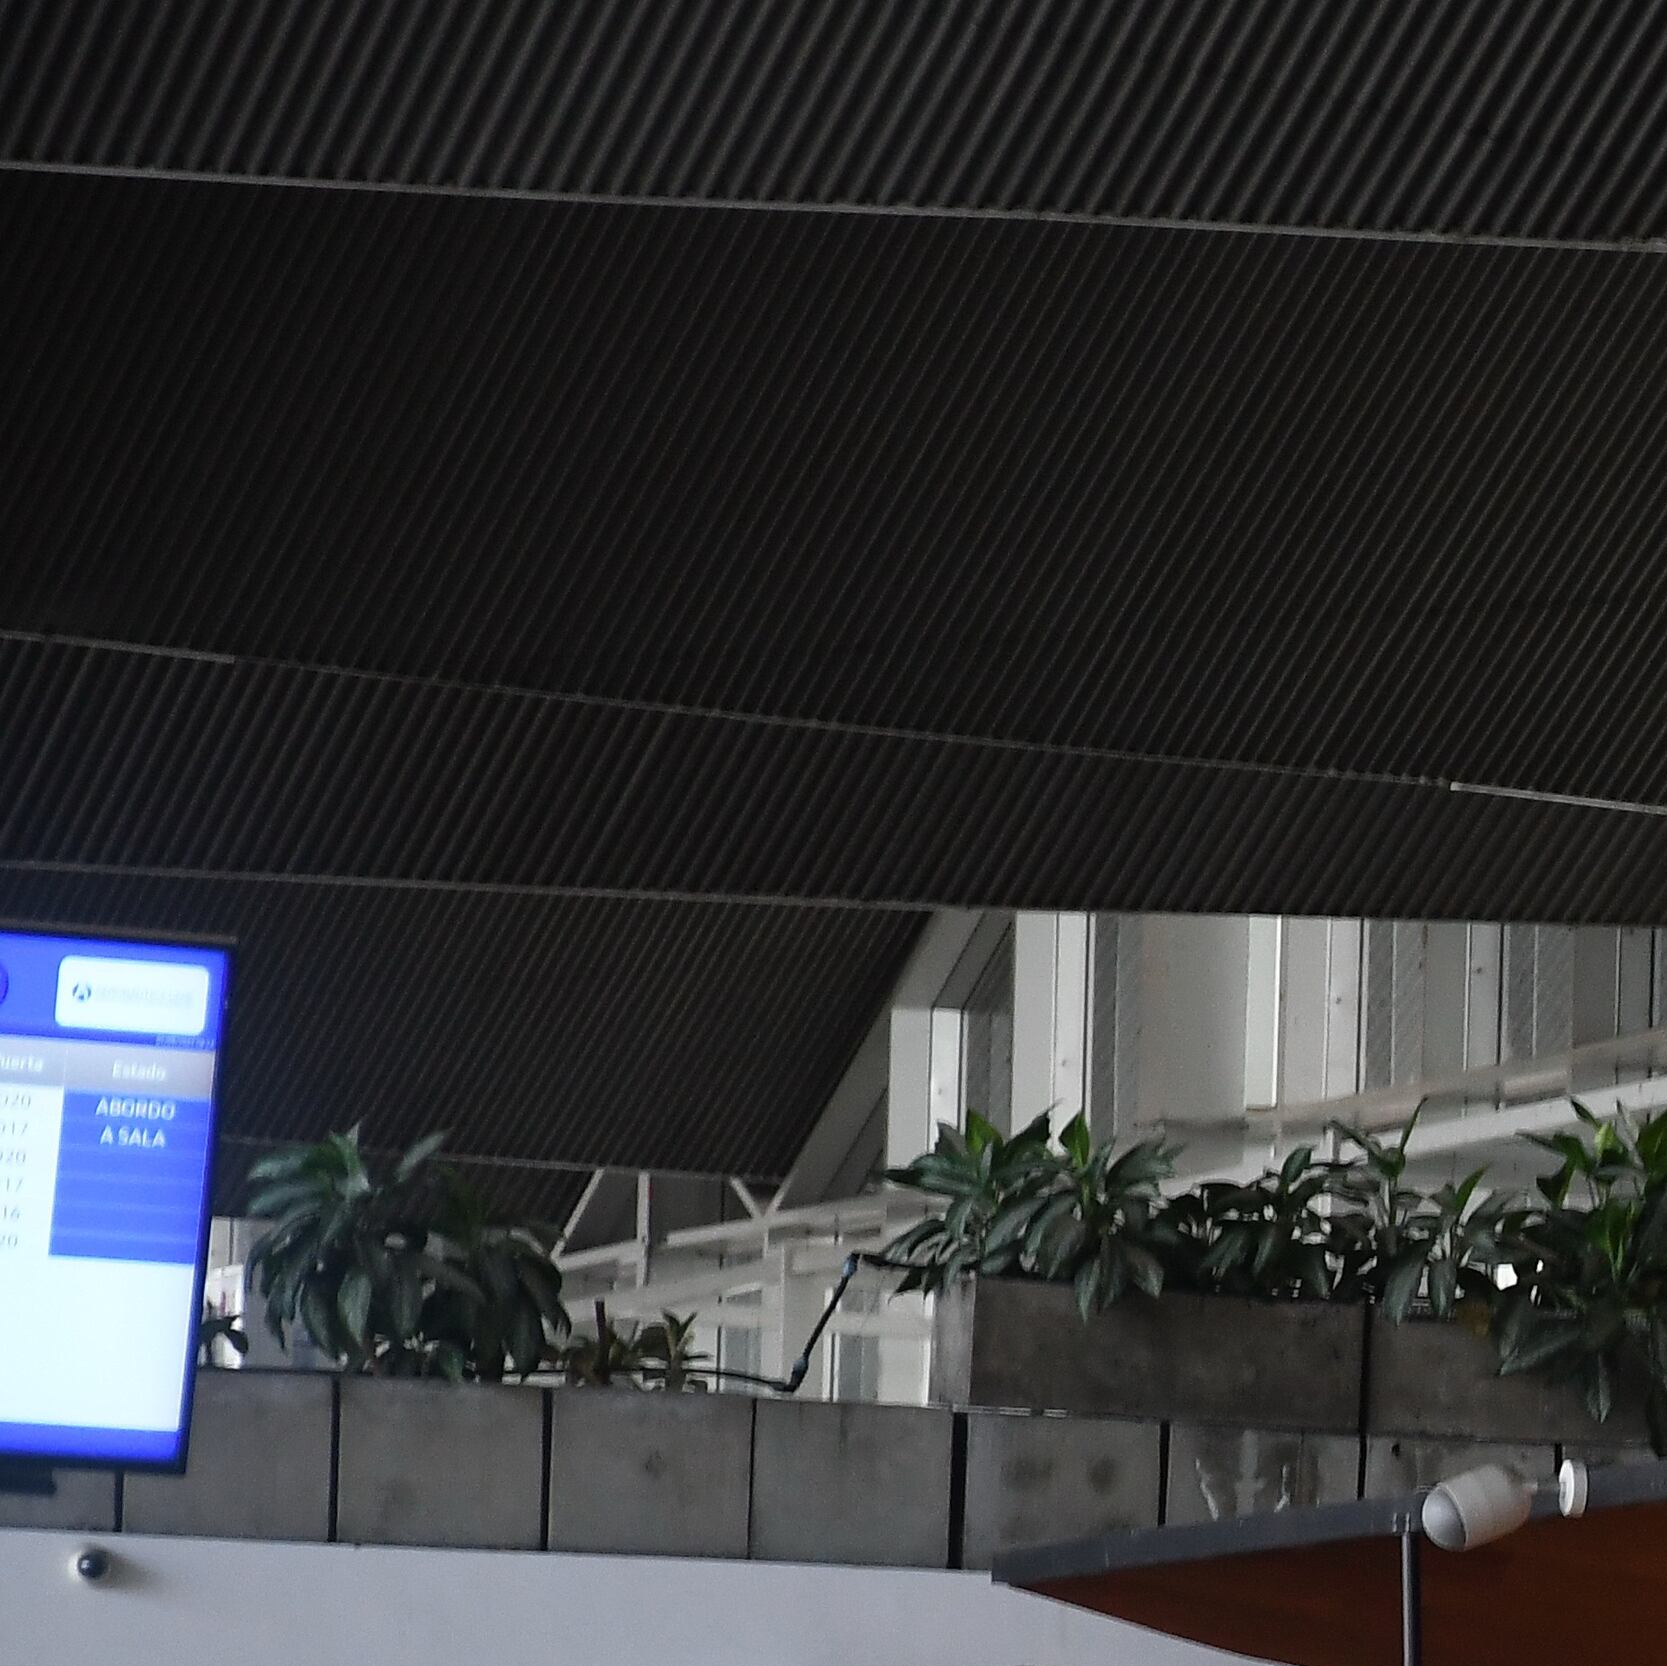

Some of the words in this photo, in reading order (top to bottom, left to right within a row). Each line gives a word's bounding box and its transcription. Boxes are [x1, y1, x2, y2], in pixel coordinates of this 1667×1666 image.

[0, 1055, 43, 1073] uerta
[112, 1059, 167, 1082] Estado
[95, 1097, 176, 1121] ABORDO
[100, 1125, 114, 1145] A
[118, 1126, 166, 1147] SALA
